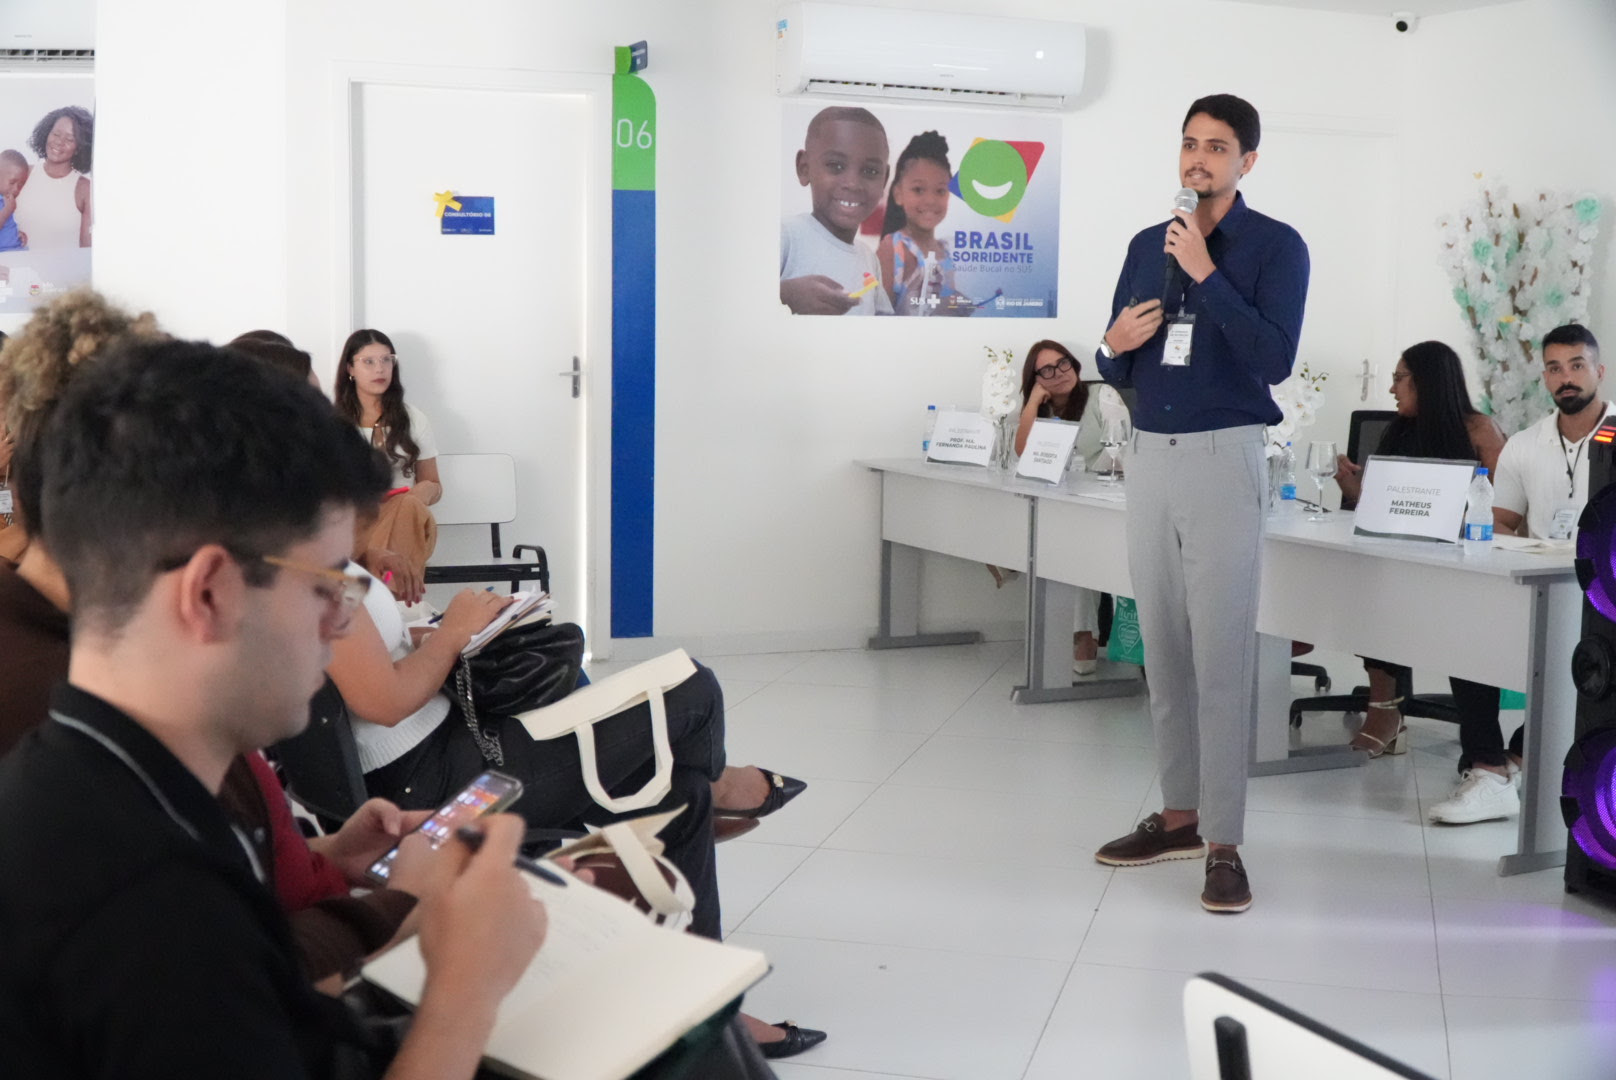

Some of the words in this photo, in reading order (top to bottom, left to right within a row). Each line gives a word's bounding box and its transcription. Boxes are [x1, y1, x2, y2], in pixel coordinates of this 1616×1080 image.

[616, 118, 653, 149] 06
[954, 230, 1034, 250] BRASIL
[952, 251, 1034, 264] SORRIDENTE
[952, 264, 978, 272] Saúde
[980, 265, 1002, 273] Bucal
[1016, 265, 1033, 274] SUS
[910, 297, 926, 305] SUS
[1386, 485, 1441, 496] PALESTRANTE
[1391, 500, 1432, 509] MATHEUS
[1389, 508, 1430, 517] FERREIRA
